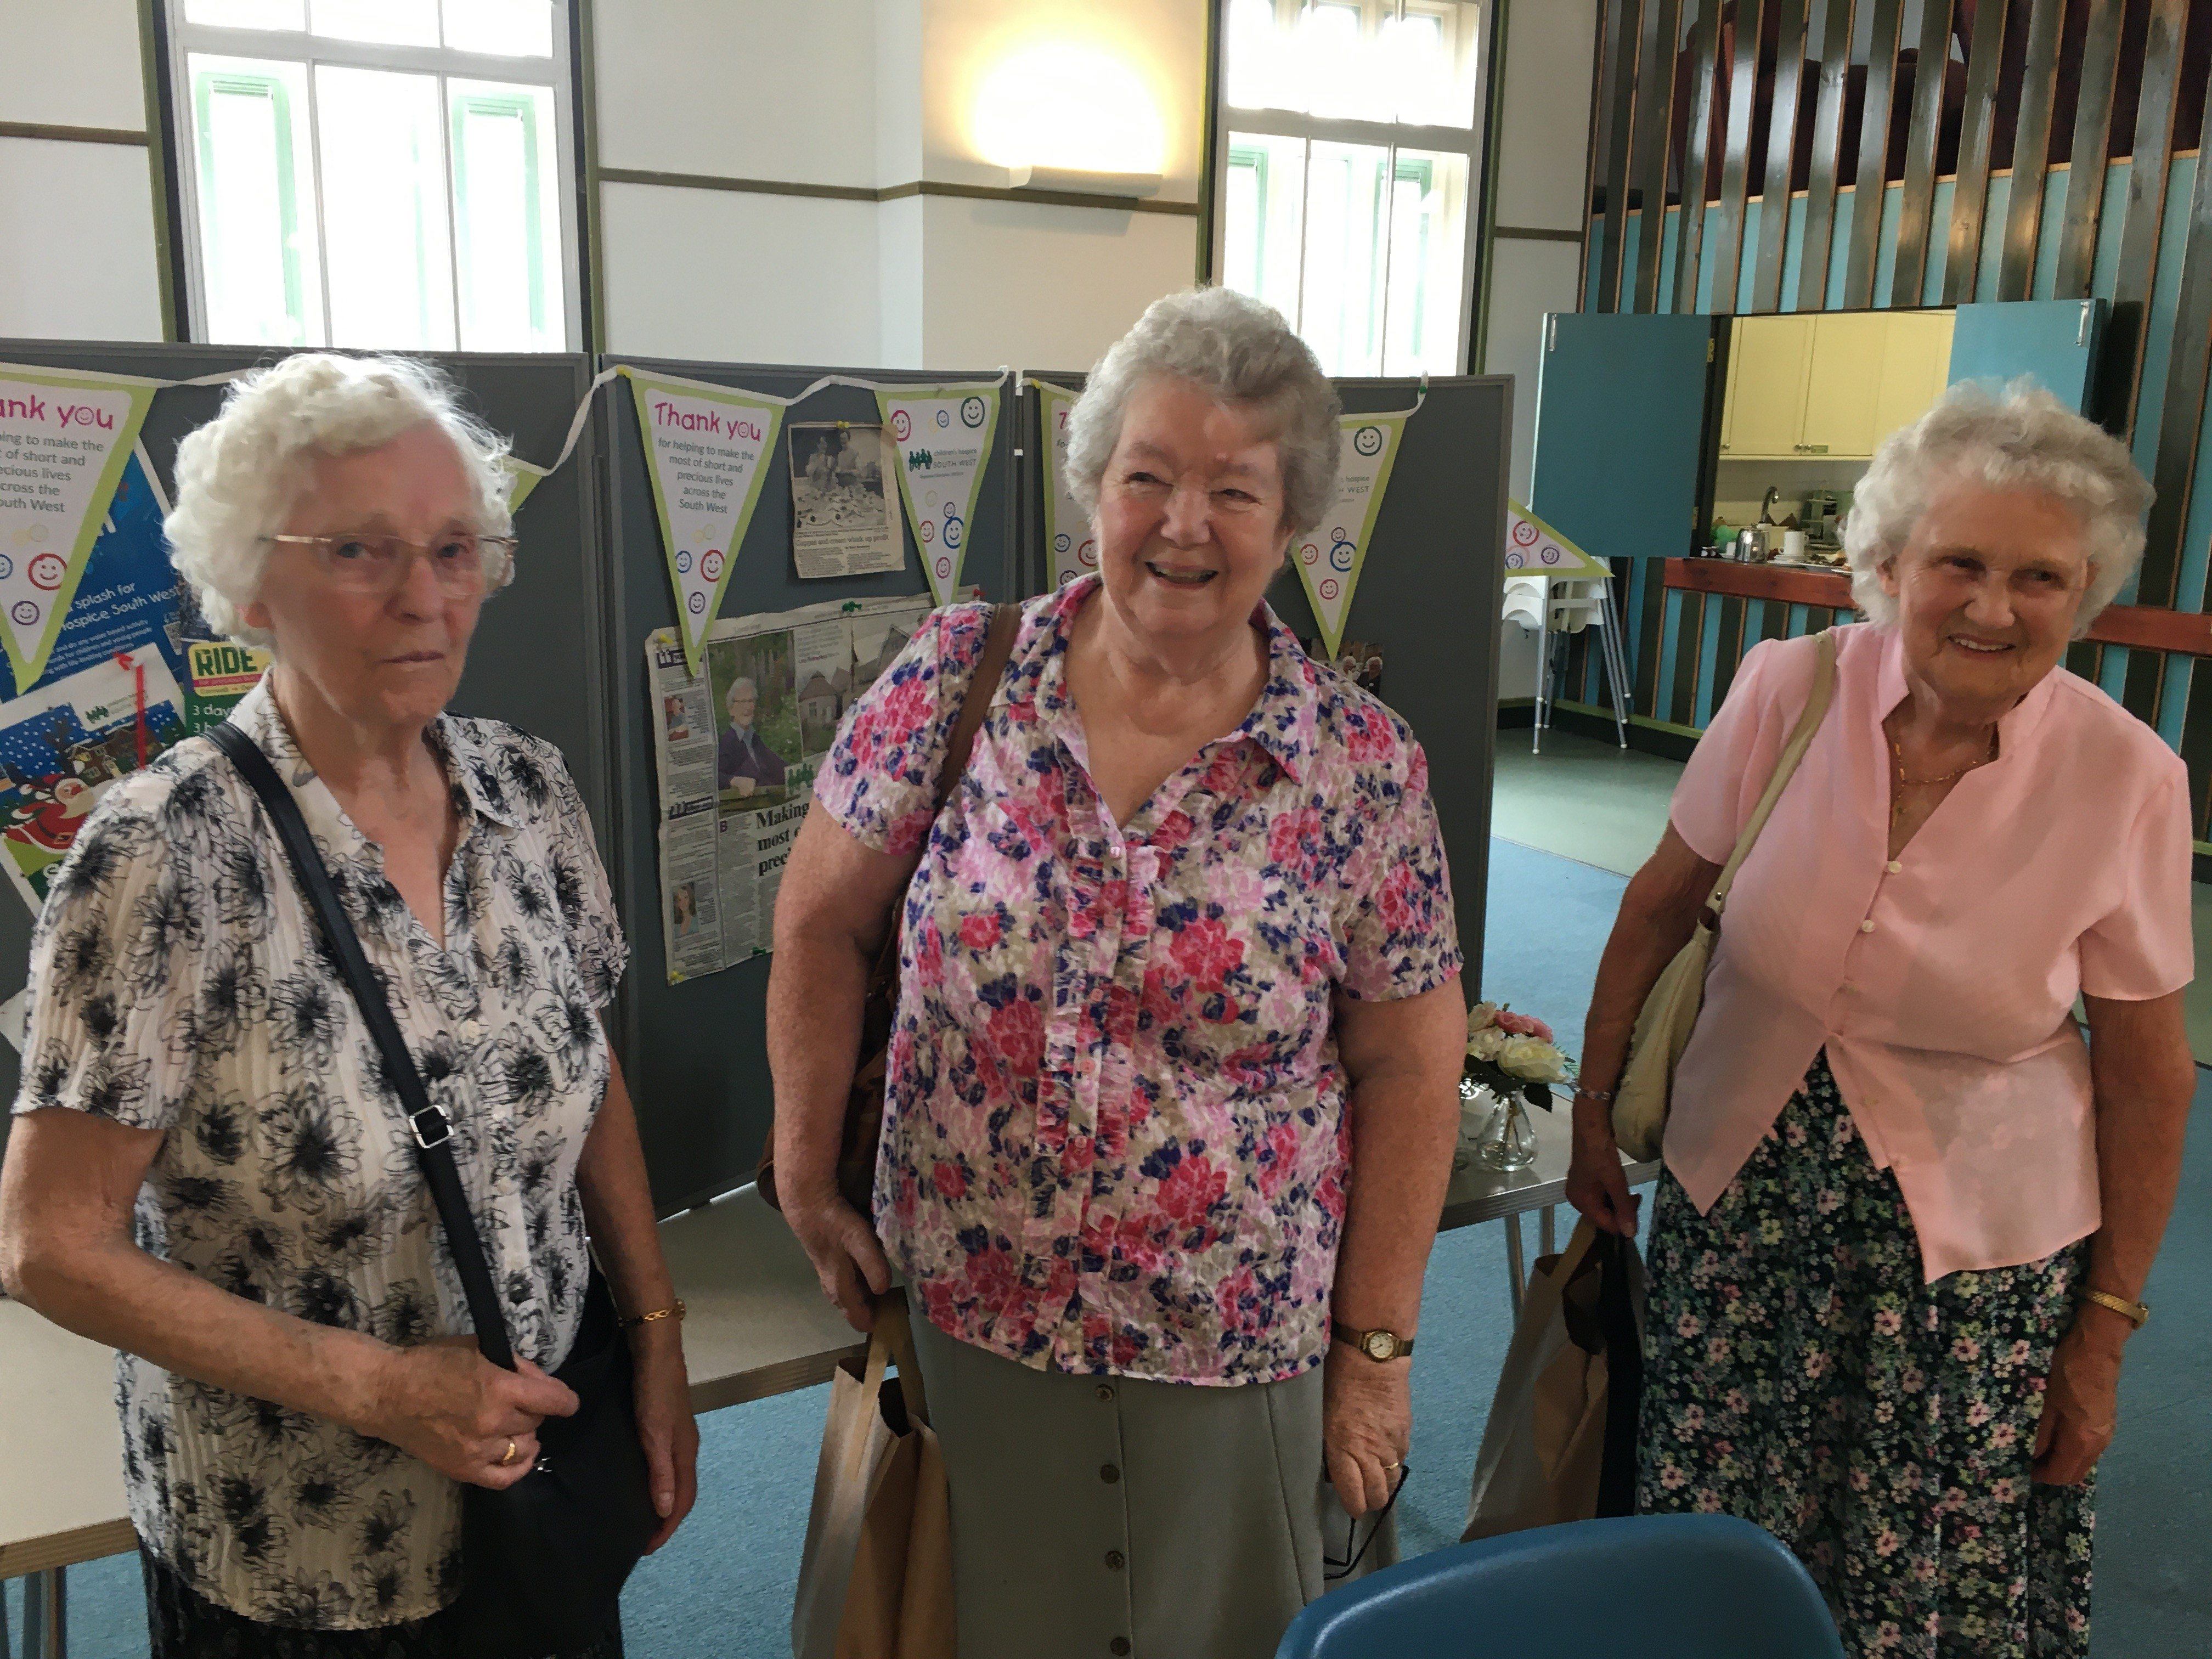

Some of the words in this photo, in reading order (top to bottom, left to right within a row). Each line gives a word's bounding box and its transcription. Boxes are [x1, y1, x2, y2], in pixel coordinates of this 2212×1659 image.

[57, 405, 113, 430] you
[654, 402, 720, 433] Thank
[726, 421, 761, 442] you
[26, 435, 39, 445] to
[44, 437, 78, 449] make
[82, 439, 104, 452] the
[658, 437, 672, 448] for
[673, 439, 704, 455] helping
[707, 445, 715, 455] to
[718, 448, 740, 459] make
[742, 450, 755, 461] the
[5, 449, 20, 459] of
[22, 450, 57, 464] short
[61, 455, 86, 466] and
[669, 455, 691, 466] most
[693, 458, 703, 467] of
[704, 459, 726, 471] short
[728, 464, 743, 473] and
[42, 467, 71, 481] lives
[677, 471, 713, 484] precious
[715, 475, 733, 486] lives
[0, 482, 35, 493] cross
[38, 484, 61, 495] the
[683, 487, 710, 498] across
[712, 489, 726, 499] the
[30, 499, 65, 512] West
[679, 499, 704, 511] South
[707, 502, 727, 514] West
[75, 588, 116, 610] splash
[117, 583, 135, 596] for
[111, 596, 148, 615] South
[194, 647, 258, 676] RIDE
[193, 705, 200, 716] 3
[193, 723, 201, 733] 3
[755, 803, 809, 829] Making
[758, 828, 789, 851] most
